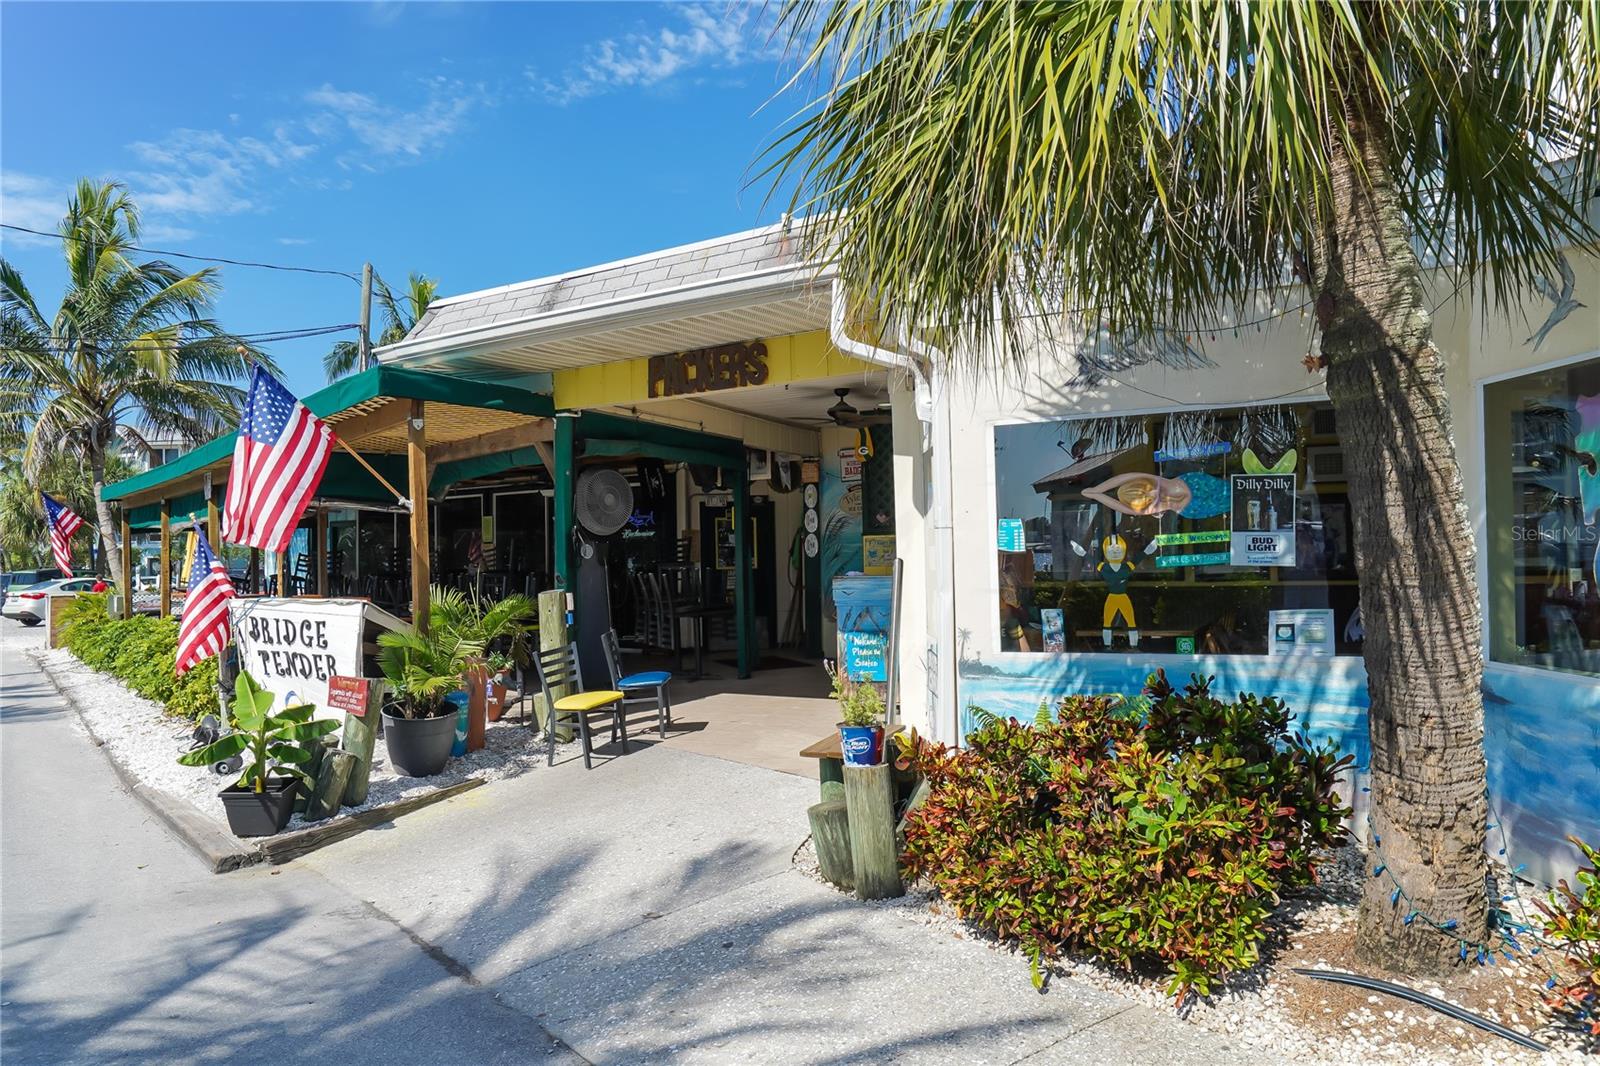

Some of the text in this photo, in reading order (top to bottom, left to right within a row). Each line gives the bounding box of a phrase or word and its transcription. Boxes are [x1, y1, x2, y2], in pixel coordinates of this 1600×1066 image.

[647, 341, 769, 398] PACKERS
[1236, 478, 1291, 492] Dilly Dilly
[1247, 544, 1278, 552] LIGHT
[1251, 537, 1274, 545] BUD
[249, 616, 328, 649] BRIDGE
[258, 650, 337, 681] TENDER
